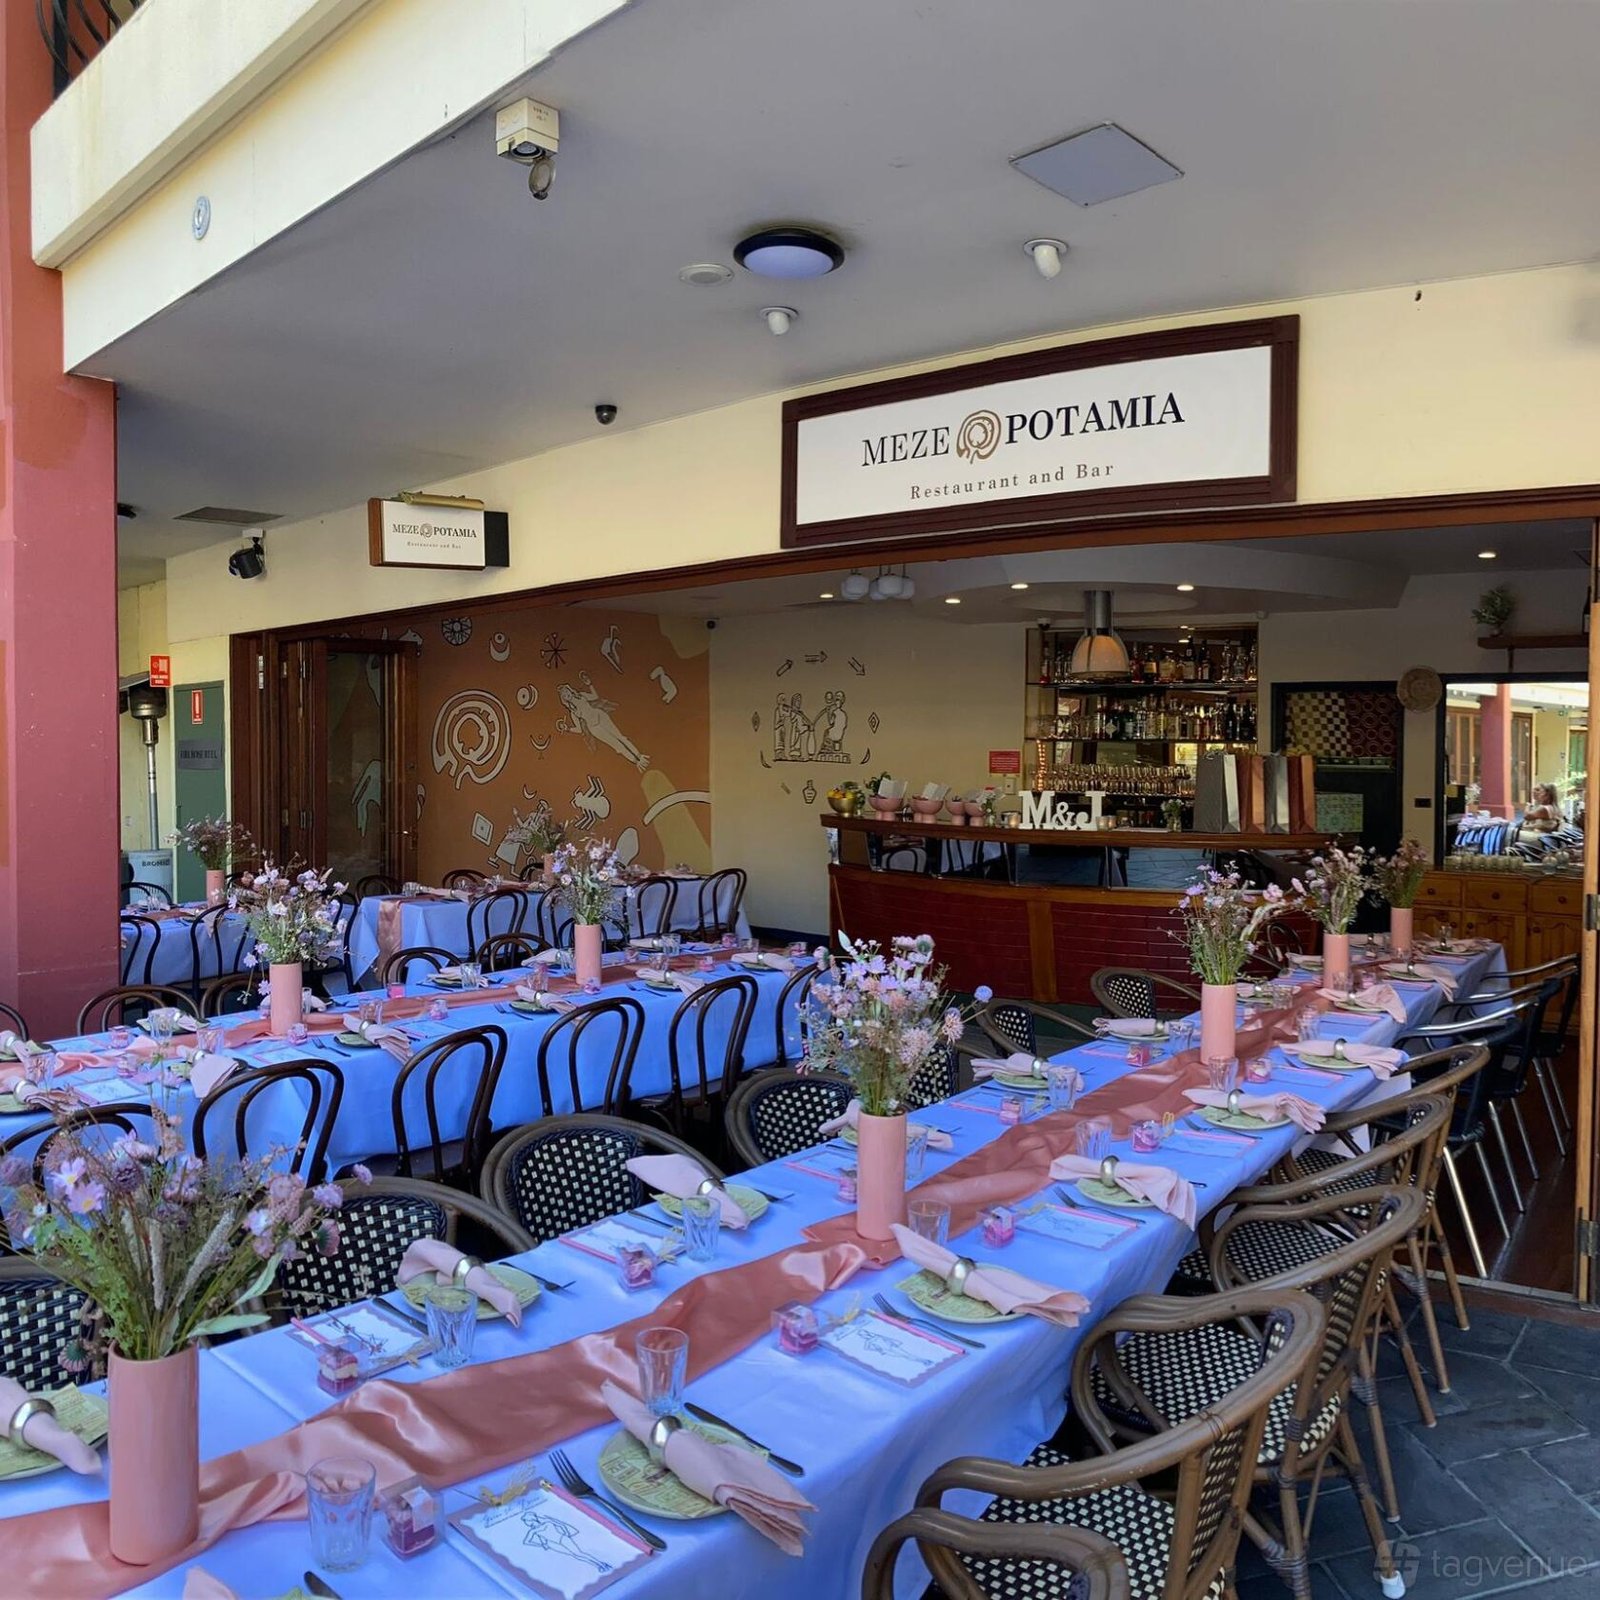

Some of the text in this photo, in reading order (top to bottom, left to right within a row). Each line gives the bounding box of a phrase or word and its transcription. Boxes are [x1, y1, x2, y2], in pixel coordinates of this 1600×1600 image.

[861, 391, 1186, 467] MEZE POTAMIA
[910, 462, 1114, 500] Restaurant and Bar
[392, 523, 477, 538] MEZE POTAMIA
[1018, 790, 1106, 831] M&J
